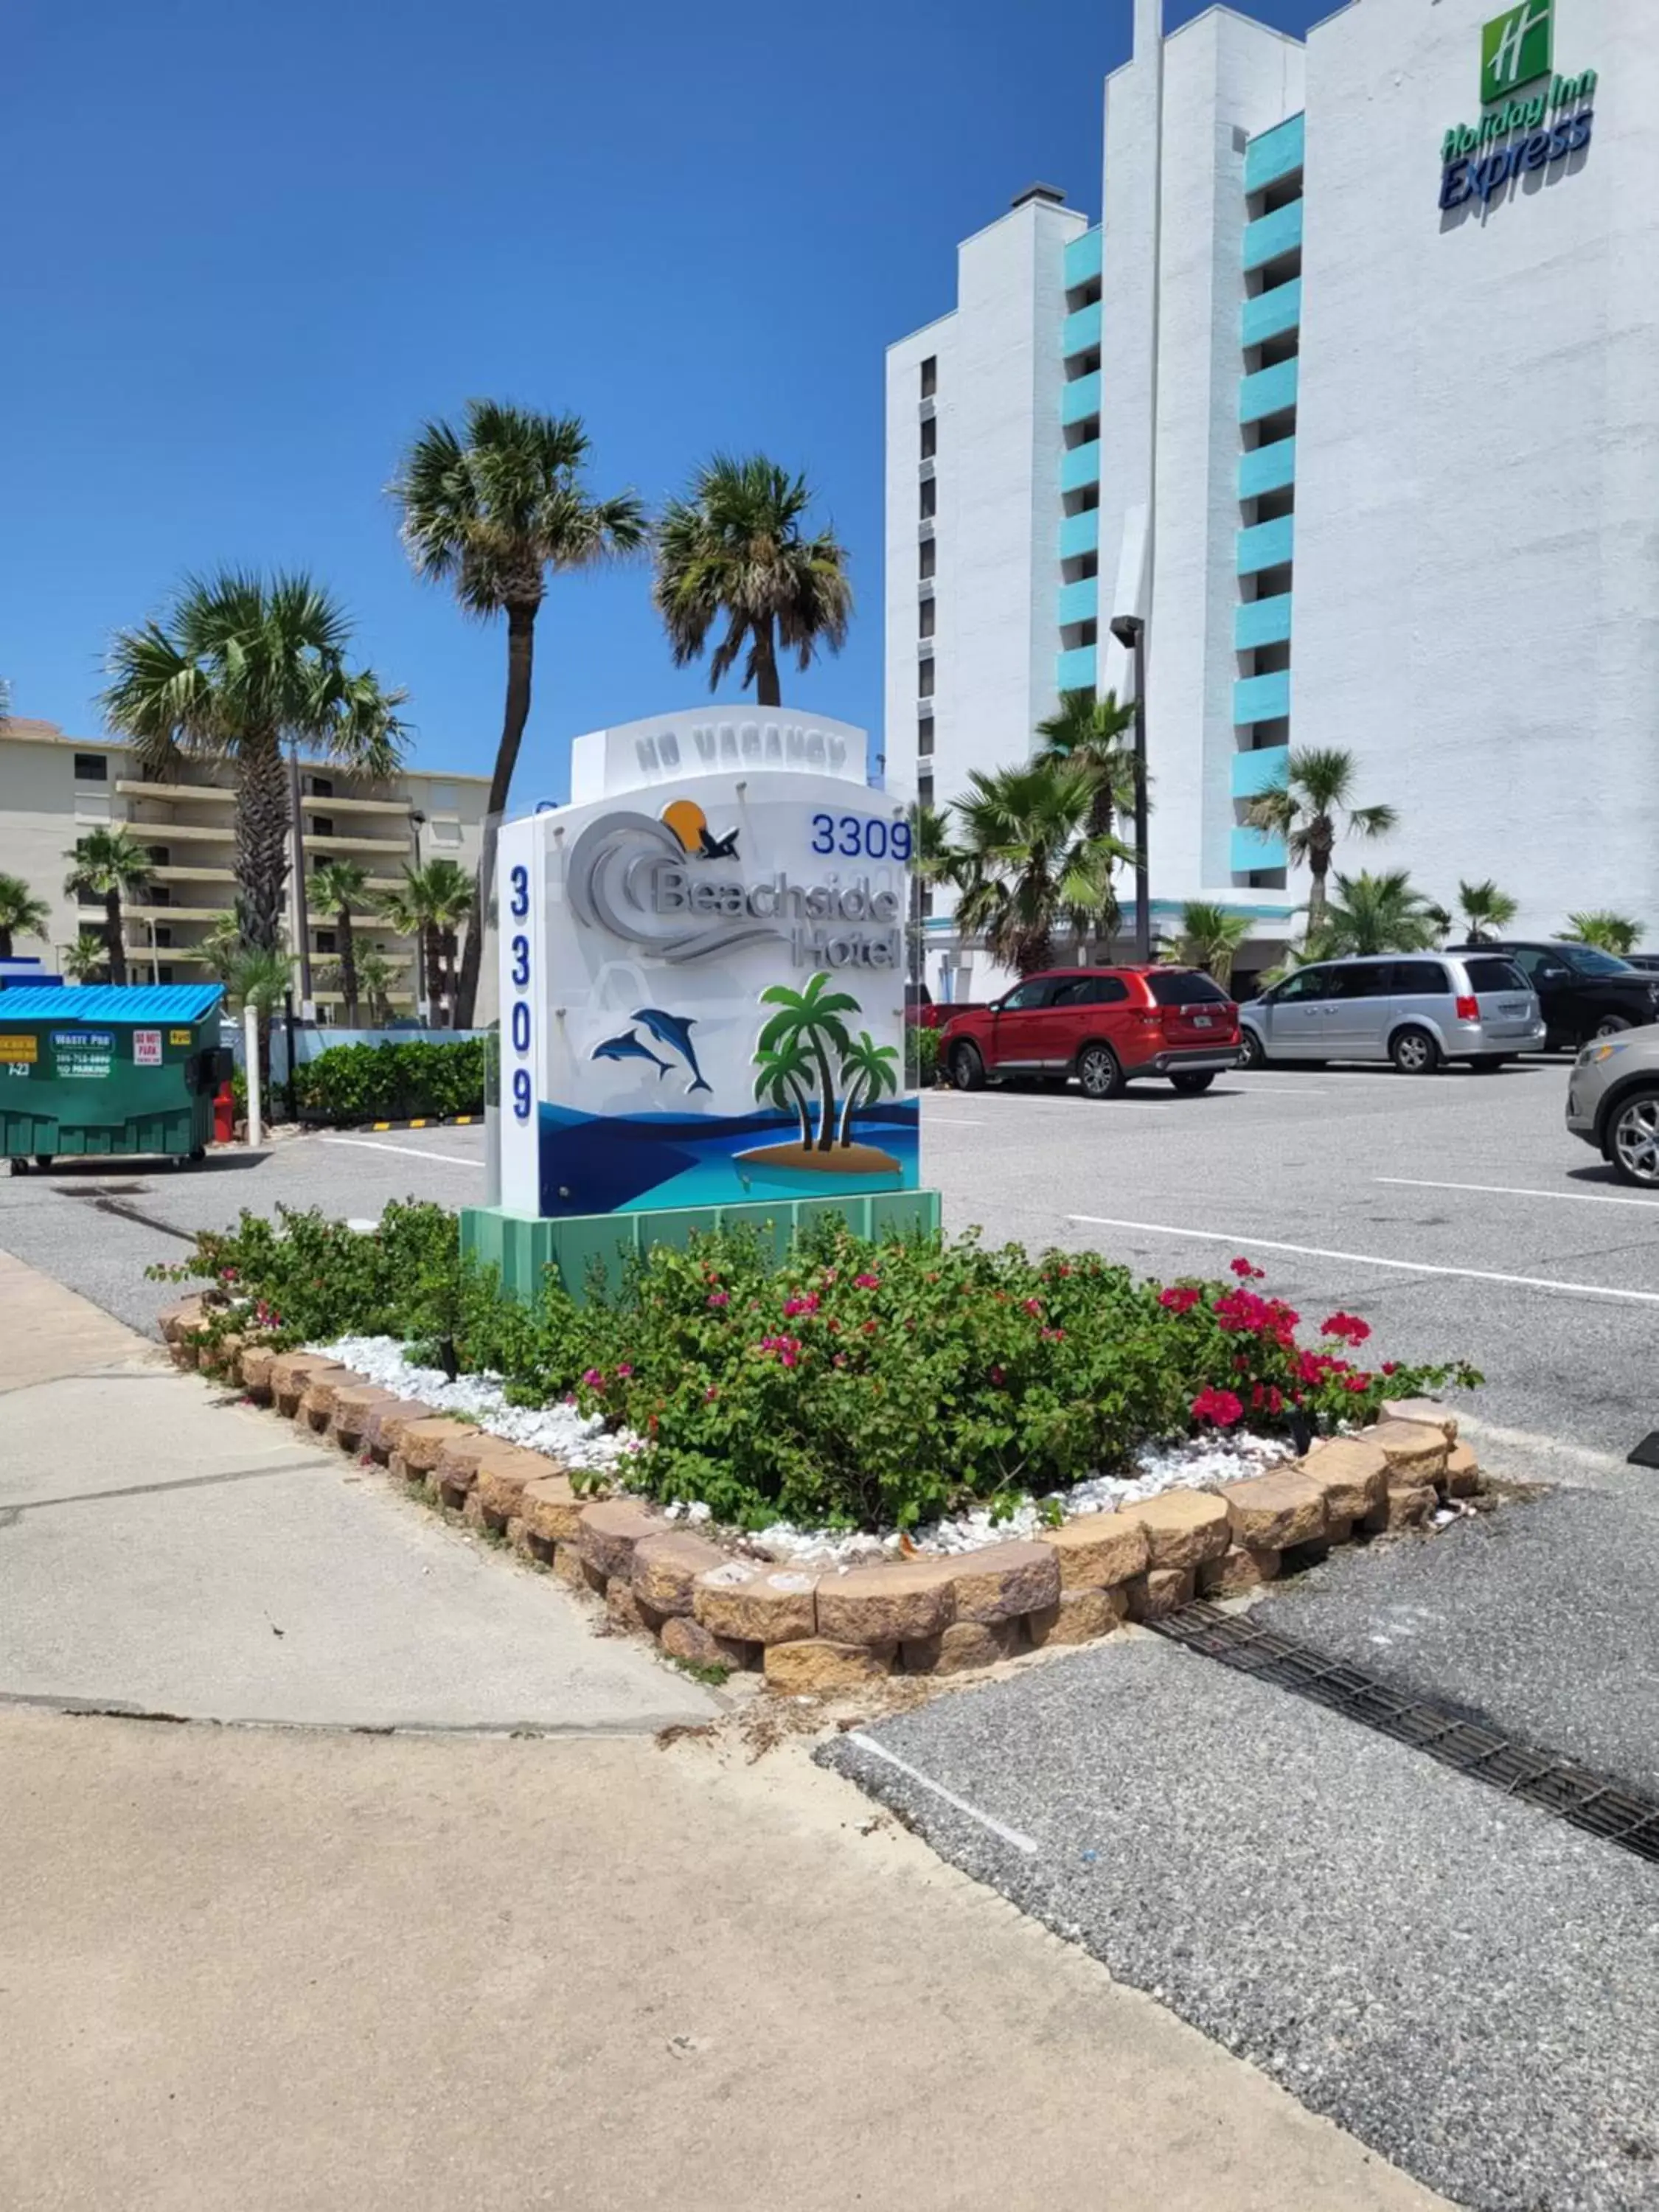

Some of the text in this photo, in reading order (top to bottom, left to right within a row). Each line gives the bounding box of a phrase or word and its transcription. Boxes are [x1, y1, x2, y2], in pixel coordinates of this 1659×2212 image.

[1441, 69, 1599, 162] Holiday Inn
[1439, 109, 1594, 210] Express
[812, 813, 912, 860] 3309
[652, 868, 900, 922] Beachside
[791, 926, 900, 969] Hotel
[510, 865, 532, 1119] 3309
[72, 1065, 110, 1074] PARKING
